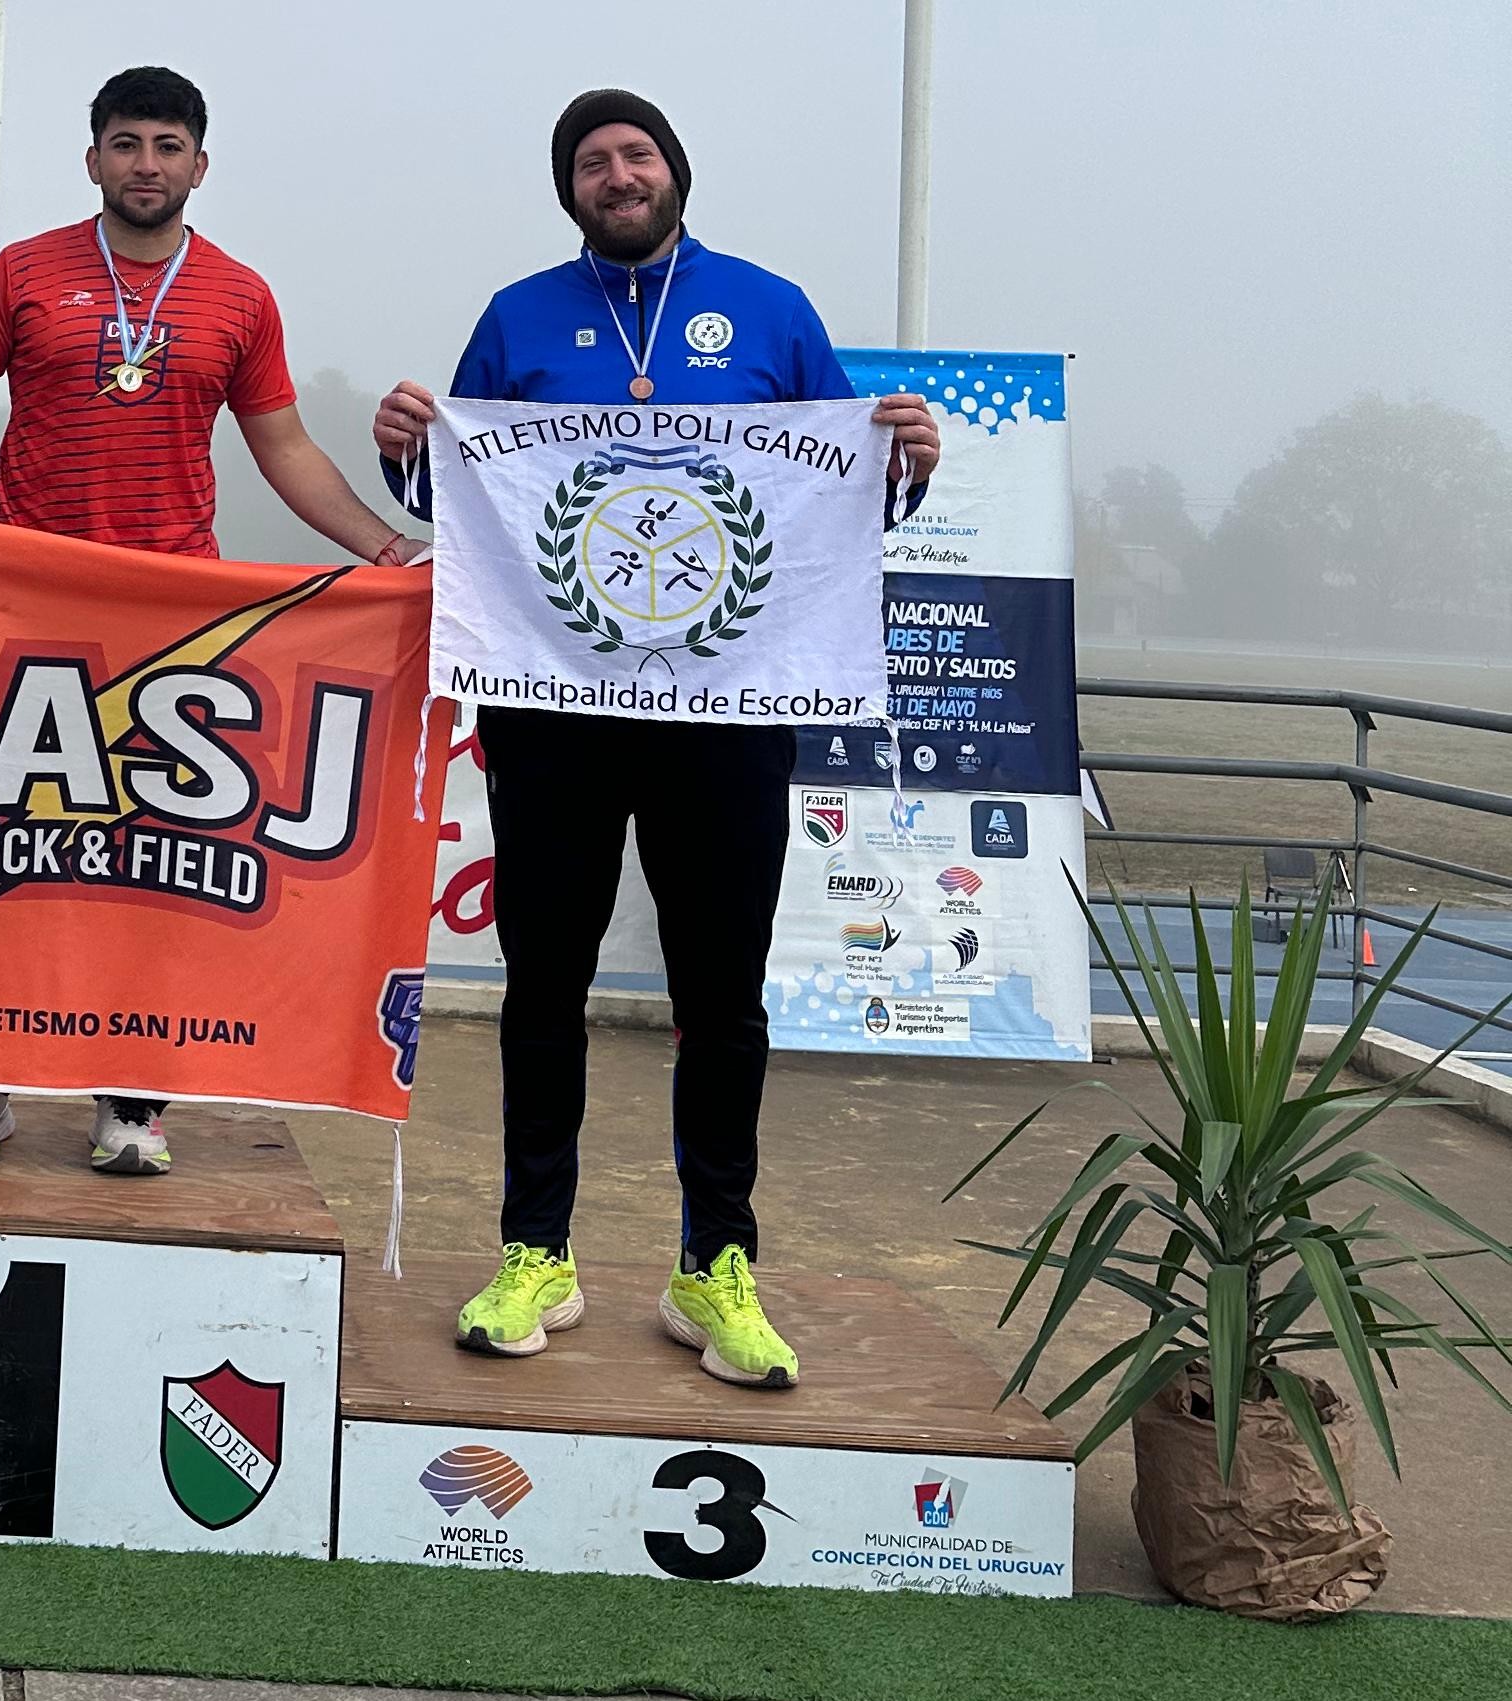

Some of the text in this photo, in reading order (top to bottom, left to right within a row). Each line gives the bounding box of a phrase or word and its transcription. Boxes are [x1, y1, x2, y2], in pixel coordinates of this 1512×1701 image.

[686, 356, 732, 369] APG
[458, 411, 857, 479] ATLETISMO POLI GARIN
[903, 526, 923, 534] DEL
[926, 527, 979, 536] URUGUAY
[888, 601, 989, 627] NACIONAL
[936, 630, 965, 653] DE
[934, 657, 947, 677] Y
[948, 658, 1016, 679] SALTOS
[452, 666, 865, 717] Municipalidad de Escobar
[895, 684, 940, 697] URUGUAY
[947, 686, 978, 698] ENTRE
[907, 698, 929, 716] DE
[932, 699, 976, 717] MAYO
[923, 719, 942, 730] CEF
[957, 720, 964, 731] 3
[993, 721, 1006, 733] La
[806, 795, 843, 806] FADER
[985, 833, 1014, 844] CADA
[80, 829, 111, 878] &
[131, 834, 258, 905] FIELD
[828, 876, 876, 892] ENARD
[940, 907, 982, 915] ATHLETICS
[895, 1003, 932, 1012] Ministerio
[934, 1014, 968, 1023] Deportes
[107, 1011, 170, 1041] SAN
[175, 1017, 257, 1048] JUAN
[896, 1023, 944, 1035] Argentina
[178, 1396, 260, 1479] FADER
[644, 1449, 767, 1581] 3
[924, 1511, 950, 1526] CDU
[441, 1526, 508, 1544] WORLD
[864, 1533, 1013, 1554] MUNICIPALIDAD DE
[423, 1544, 524, 1564] ATHLETICS
[811, 1549, 1065, 1577] CONCEPCIÓN DEL URUGUAY
[889, 1571, 933, 1588] Ciudad
